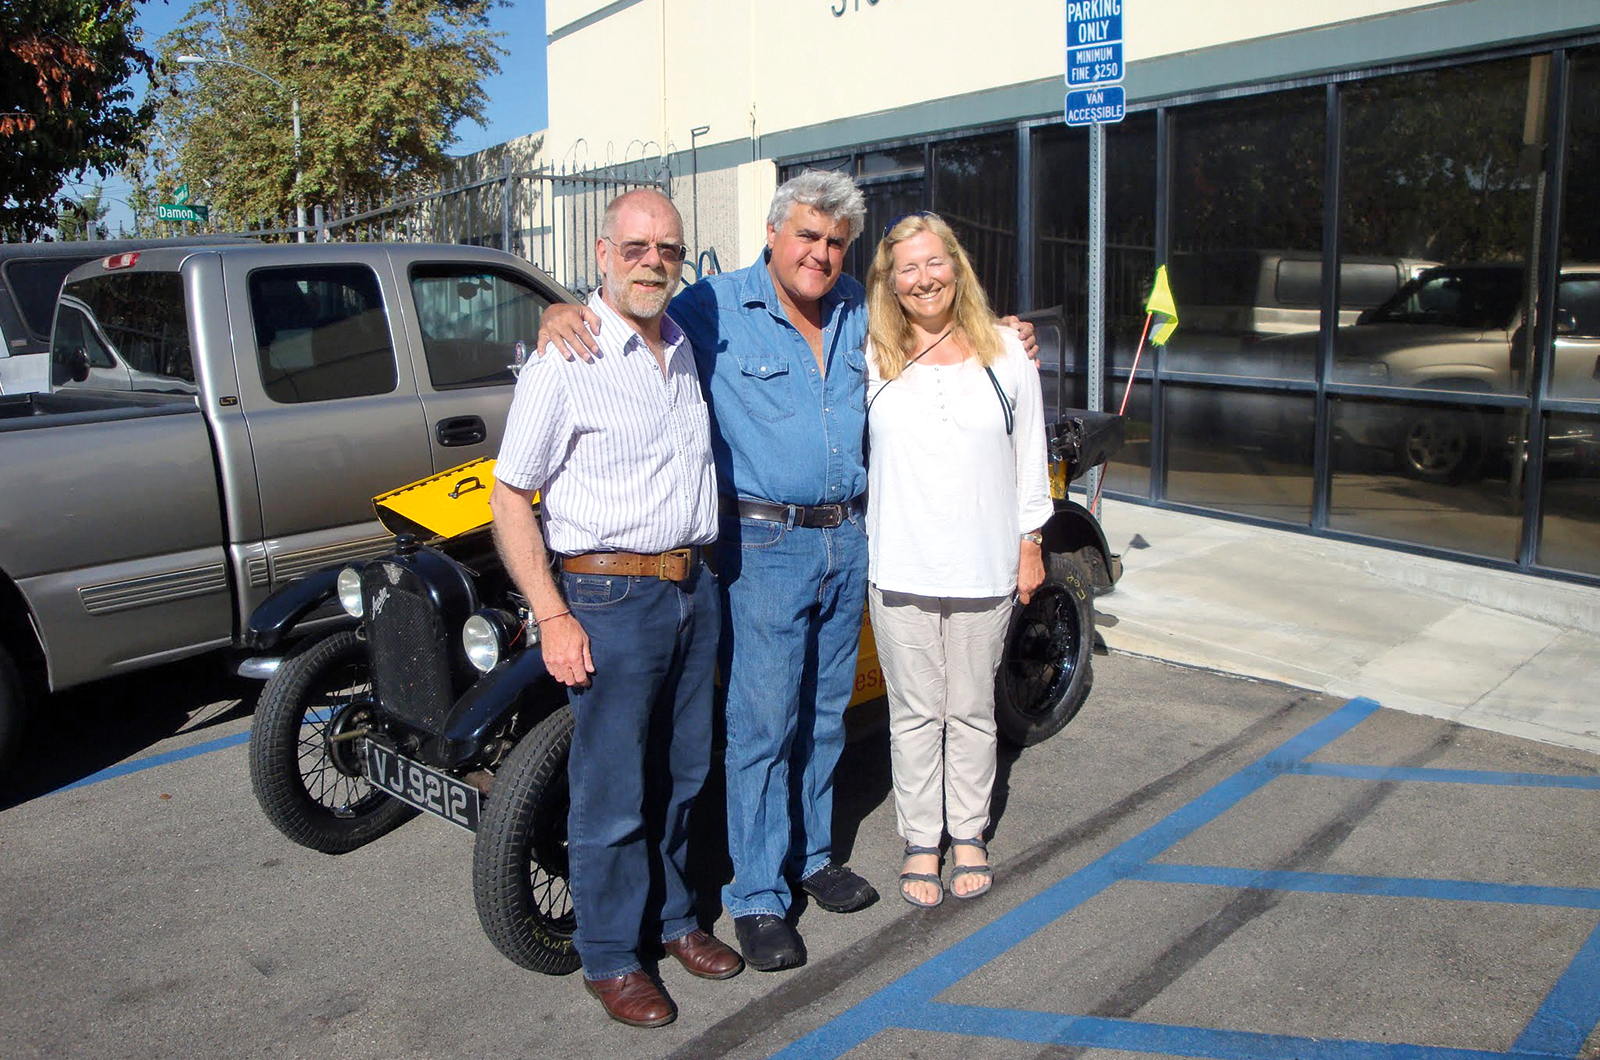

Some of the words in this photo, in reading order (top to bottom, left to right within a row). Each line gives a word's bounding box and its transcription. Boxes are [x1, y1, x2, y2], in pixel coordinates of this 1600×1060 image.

[1068, 0, 1121, 23] PARKING
[1079, 20, 1109, 43] ONLY
[1076, 47, 1113, 64] MINIMUM
[1072, 66, 1090, 81] FINE
[1095, 62, 1118, 79] $250
[1086, 92, 1104, 105] VAN
[1068, 105, 1122, 121] ACCESSIBLE
[159, 206, 193, 219] Damon
